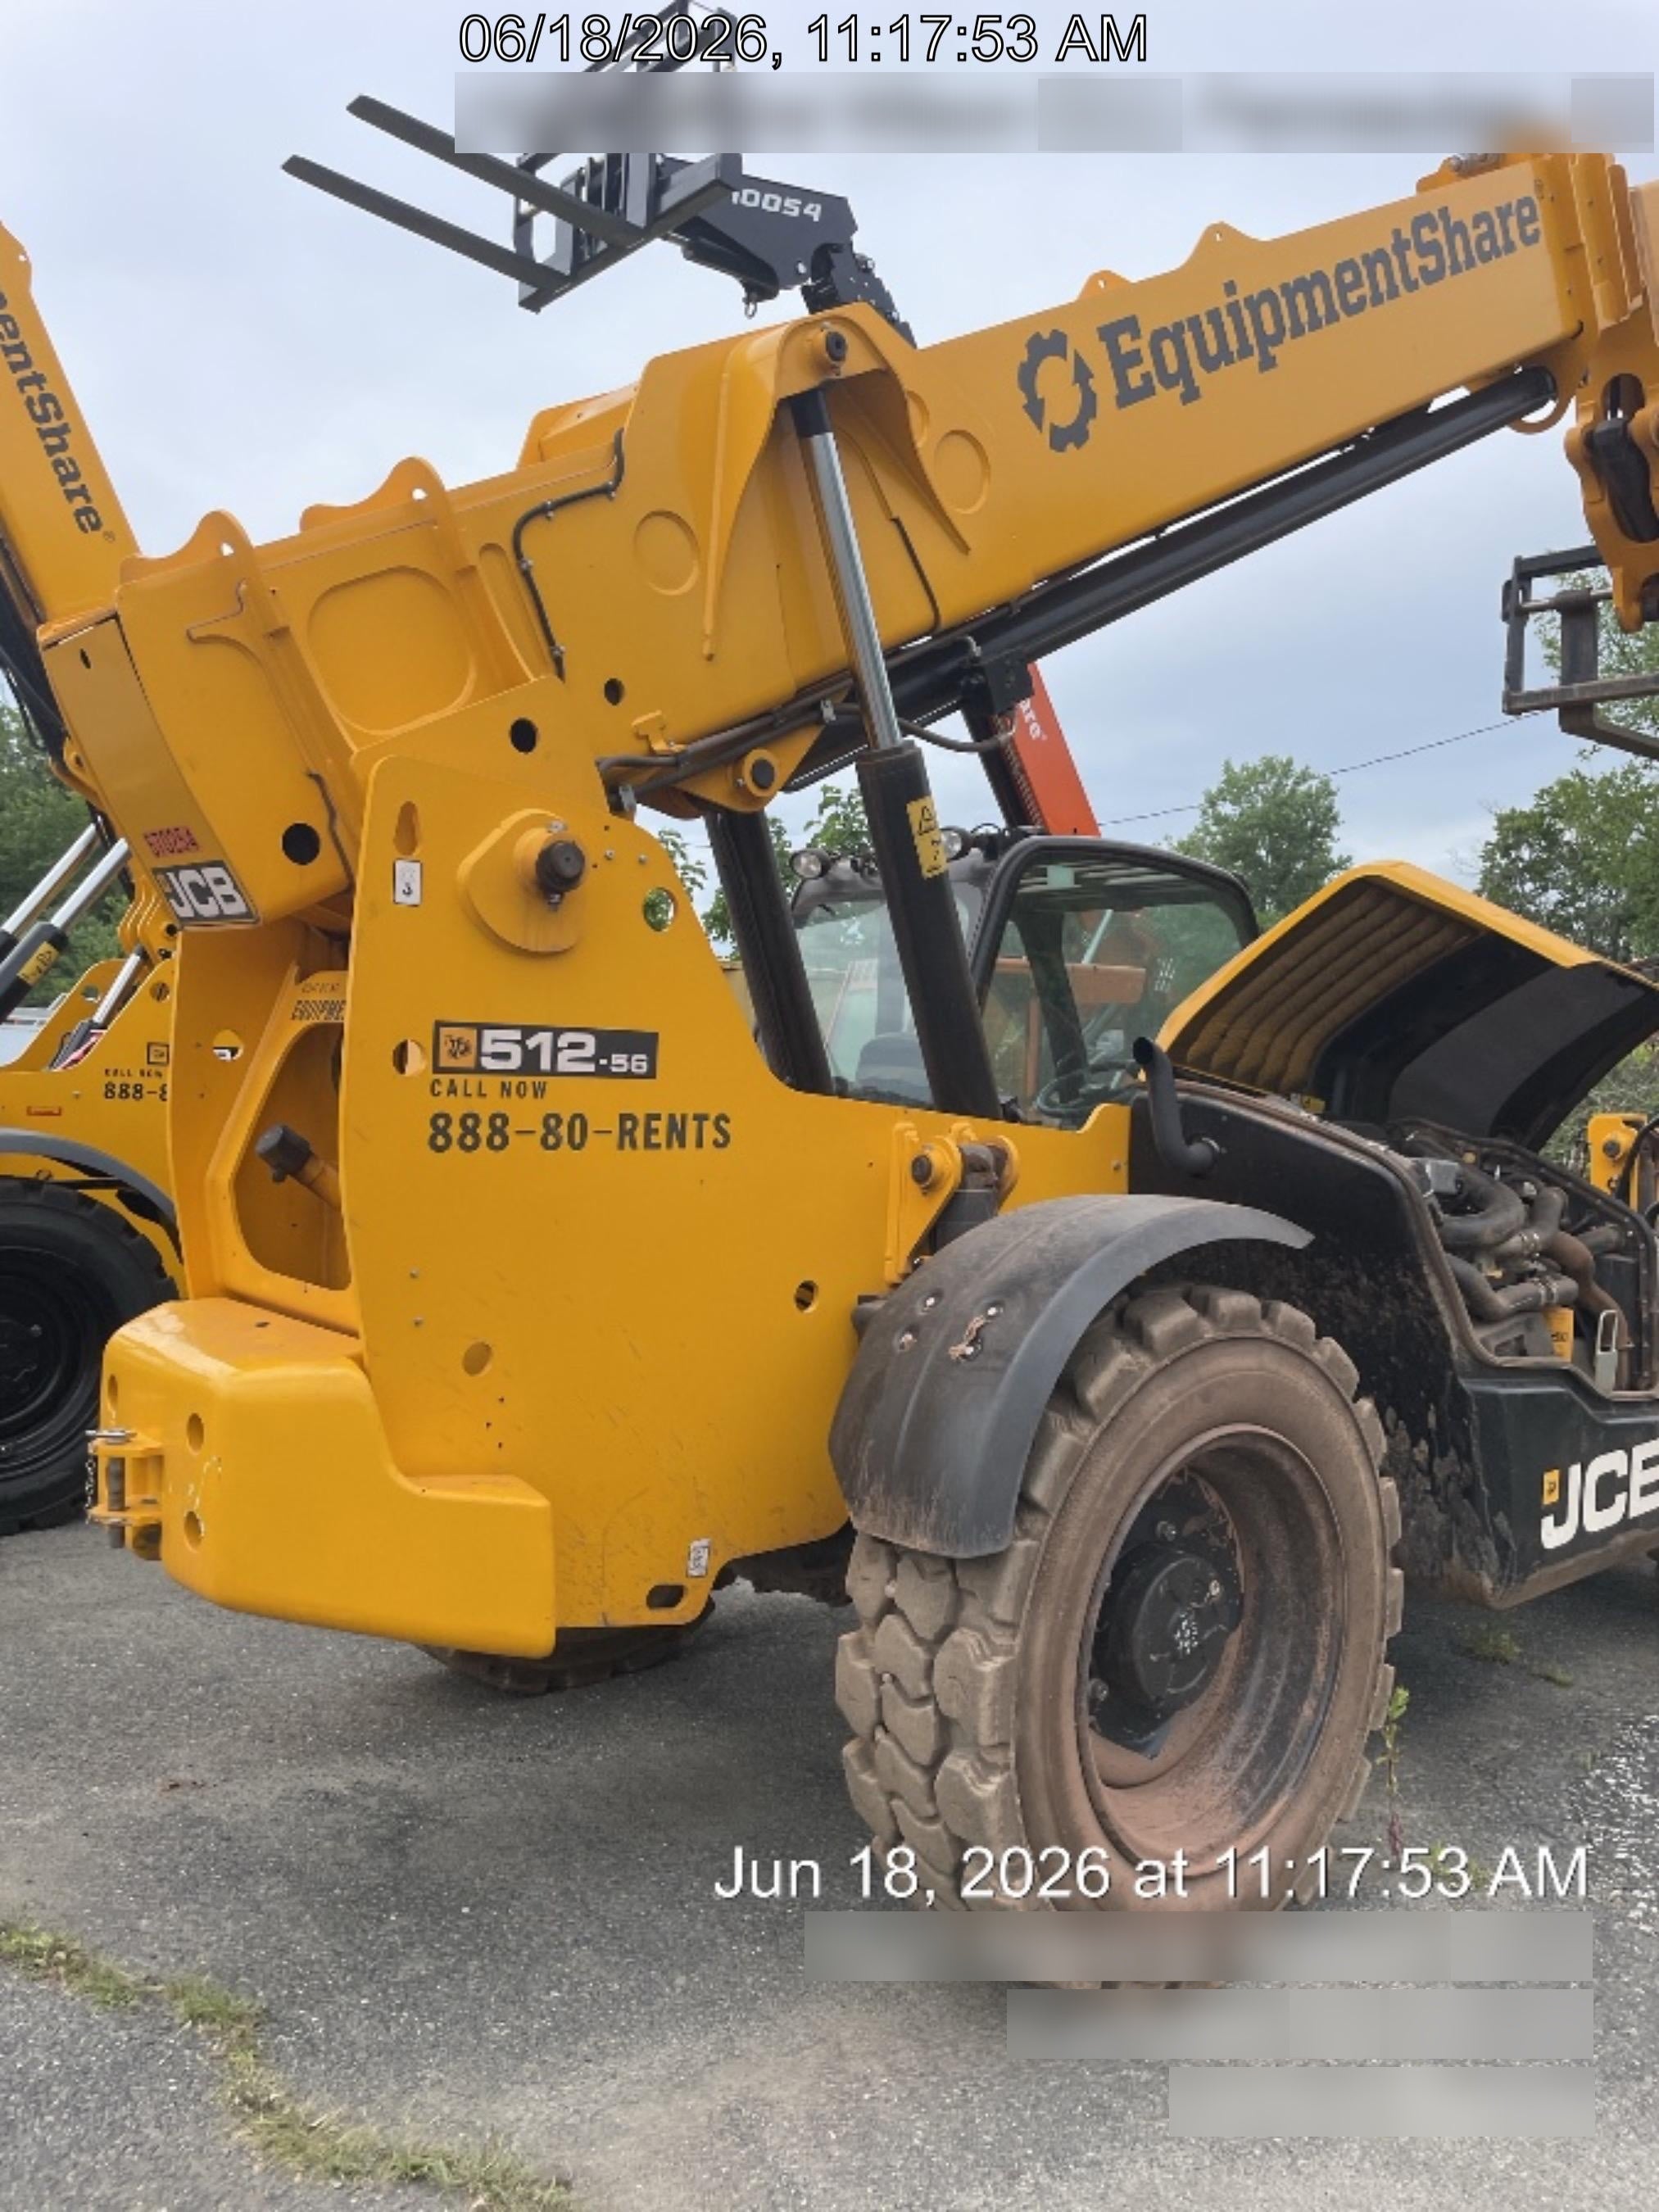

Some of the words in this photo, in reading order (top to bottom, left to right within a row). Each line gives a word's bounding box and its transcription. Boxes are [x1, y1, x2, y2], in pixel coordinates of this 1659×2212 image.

[1097, 193, 1541, 410] EquipmentShare
[0, 291, 103, 535] entShare
[166, 866, 248, 918] JCB
[480, 1029, 649, 1073] 512-56
[430, 1078, 487, 1098] CALL
[501, 1081, 547, 1099] NOW
[428, 1111, 732, 1154] 888-80-RENTS
